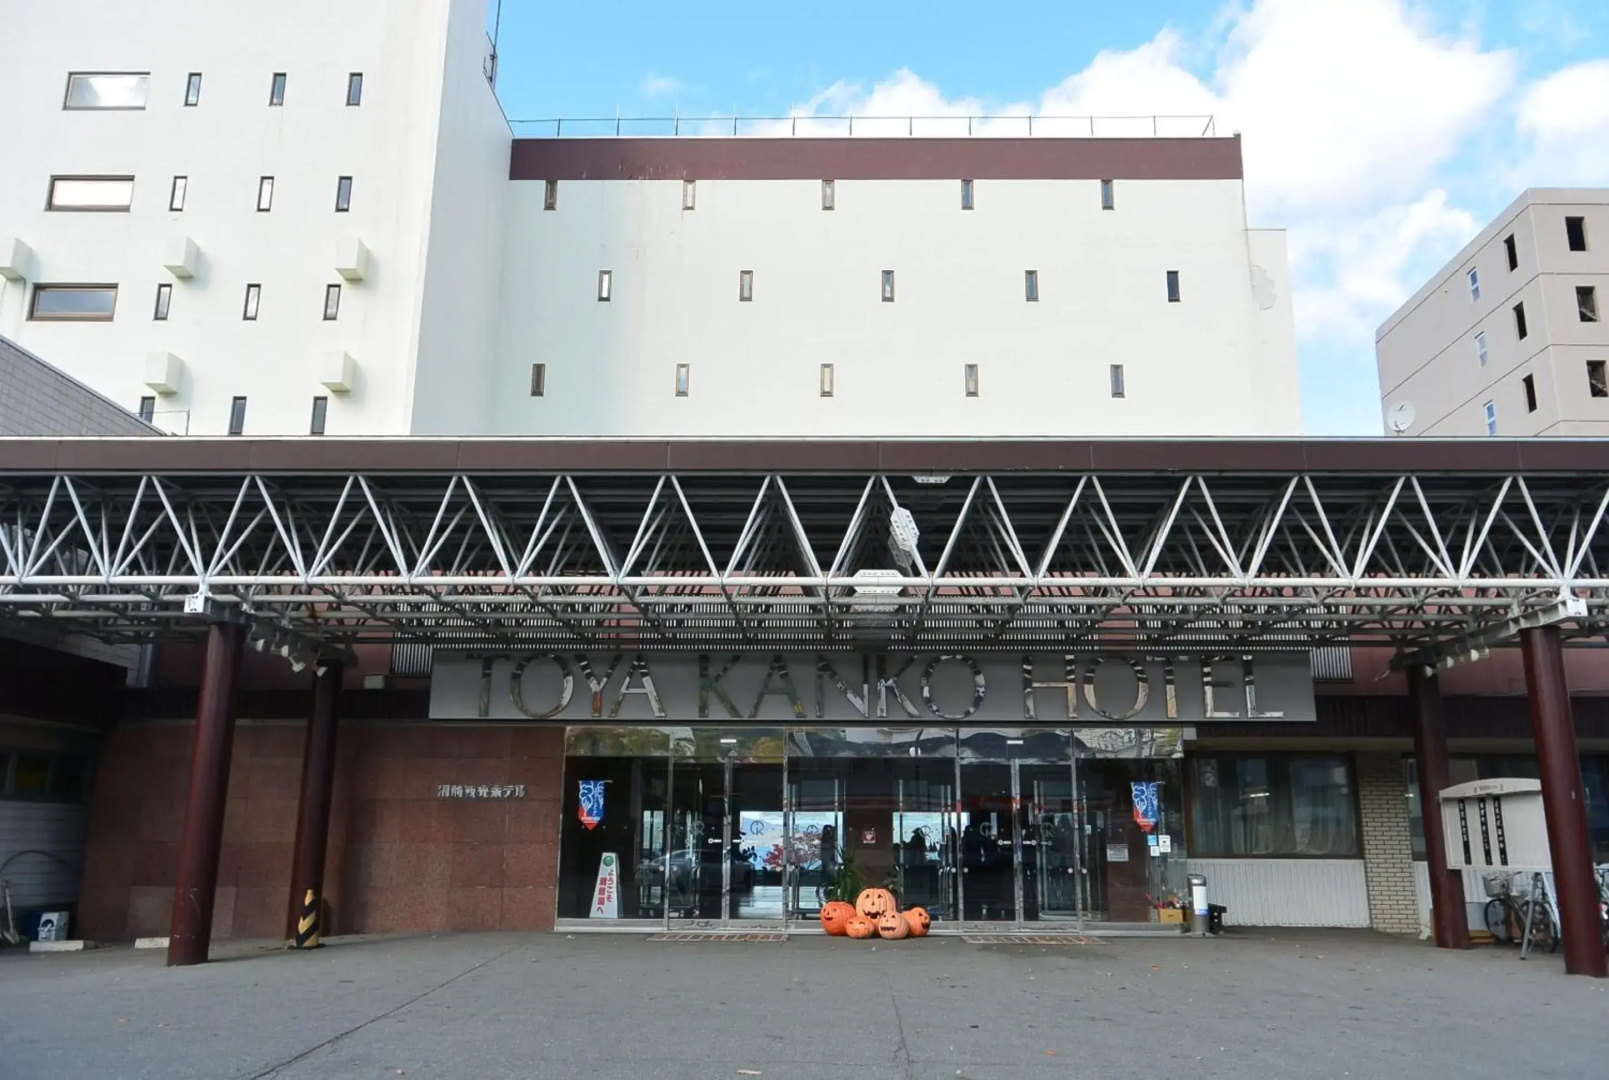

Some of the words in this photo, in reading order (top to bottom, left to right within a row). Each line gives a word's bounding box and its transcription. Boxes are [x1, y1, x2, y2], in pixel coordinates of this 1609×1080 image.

[465, 653, 667, 719] TOYA
[698, 653, 986, 719] KANKO
[1021, 654, 1284, 720] HOTEL
